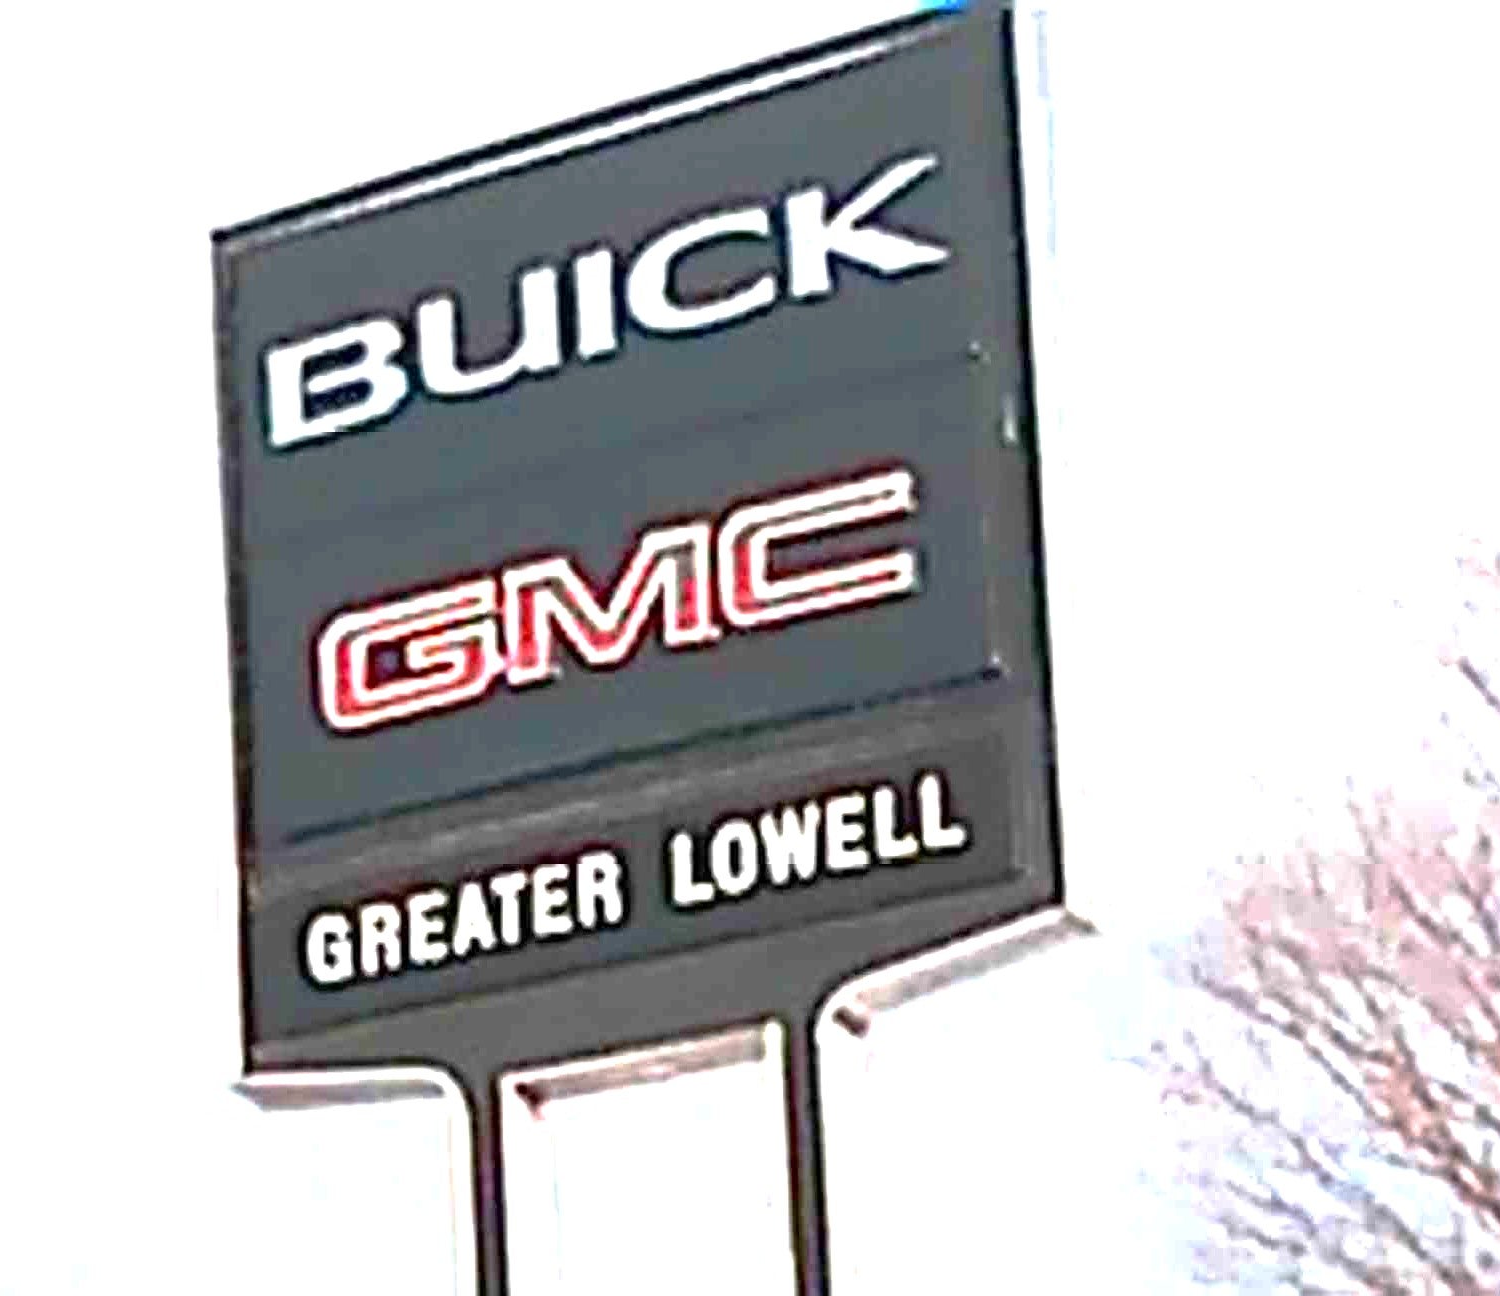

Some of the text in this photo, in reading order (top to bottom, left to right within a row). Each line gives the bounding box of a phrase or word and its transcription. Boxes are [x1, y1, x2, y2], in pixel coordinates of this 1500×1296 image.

[265, 155, 950, 447] BUICK
[315, 466, 919, 731] GMC
[304, 774, 968, 986] GREATER LOWELL
